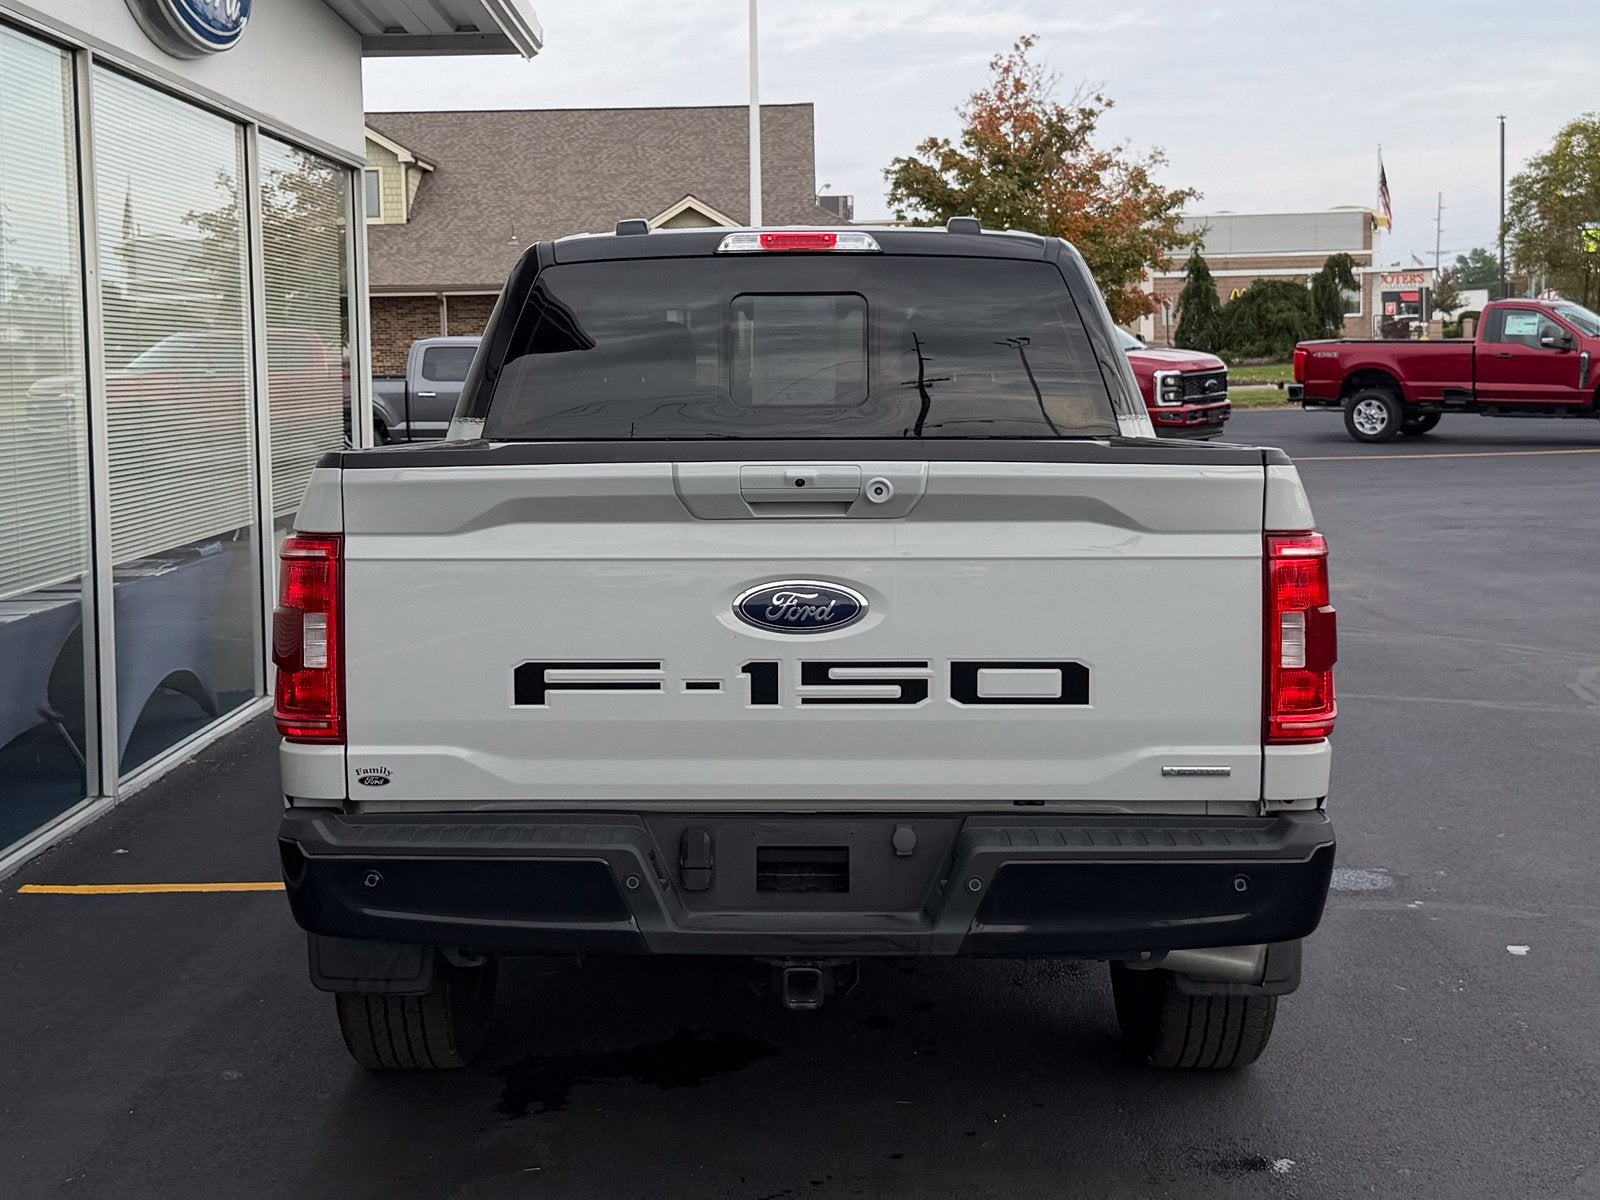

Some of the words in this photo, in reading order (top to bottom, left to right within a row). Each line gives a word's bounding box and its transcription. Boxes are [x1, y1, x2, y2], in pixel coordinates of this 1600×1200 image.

[765, 591, 837, 621] Ford
[512, 659, 1091, 706] F-150
[355, 766, 393, 777] Family
[364, 777, 385, 785] Ford
